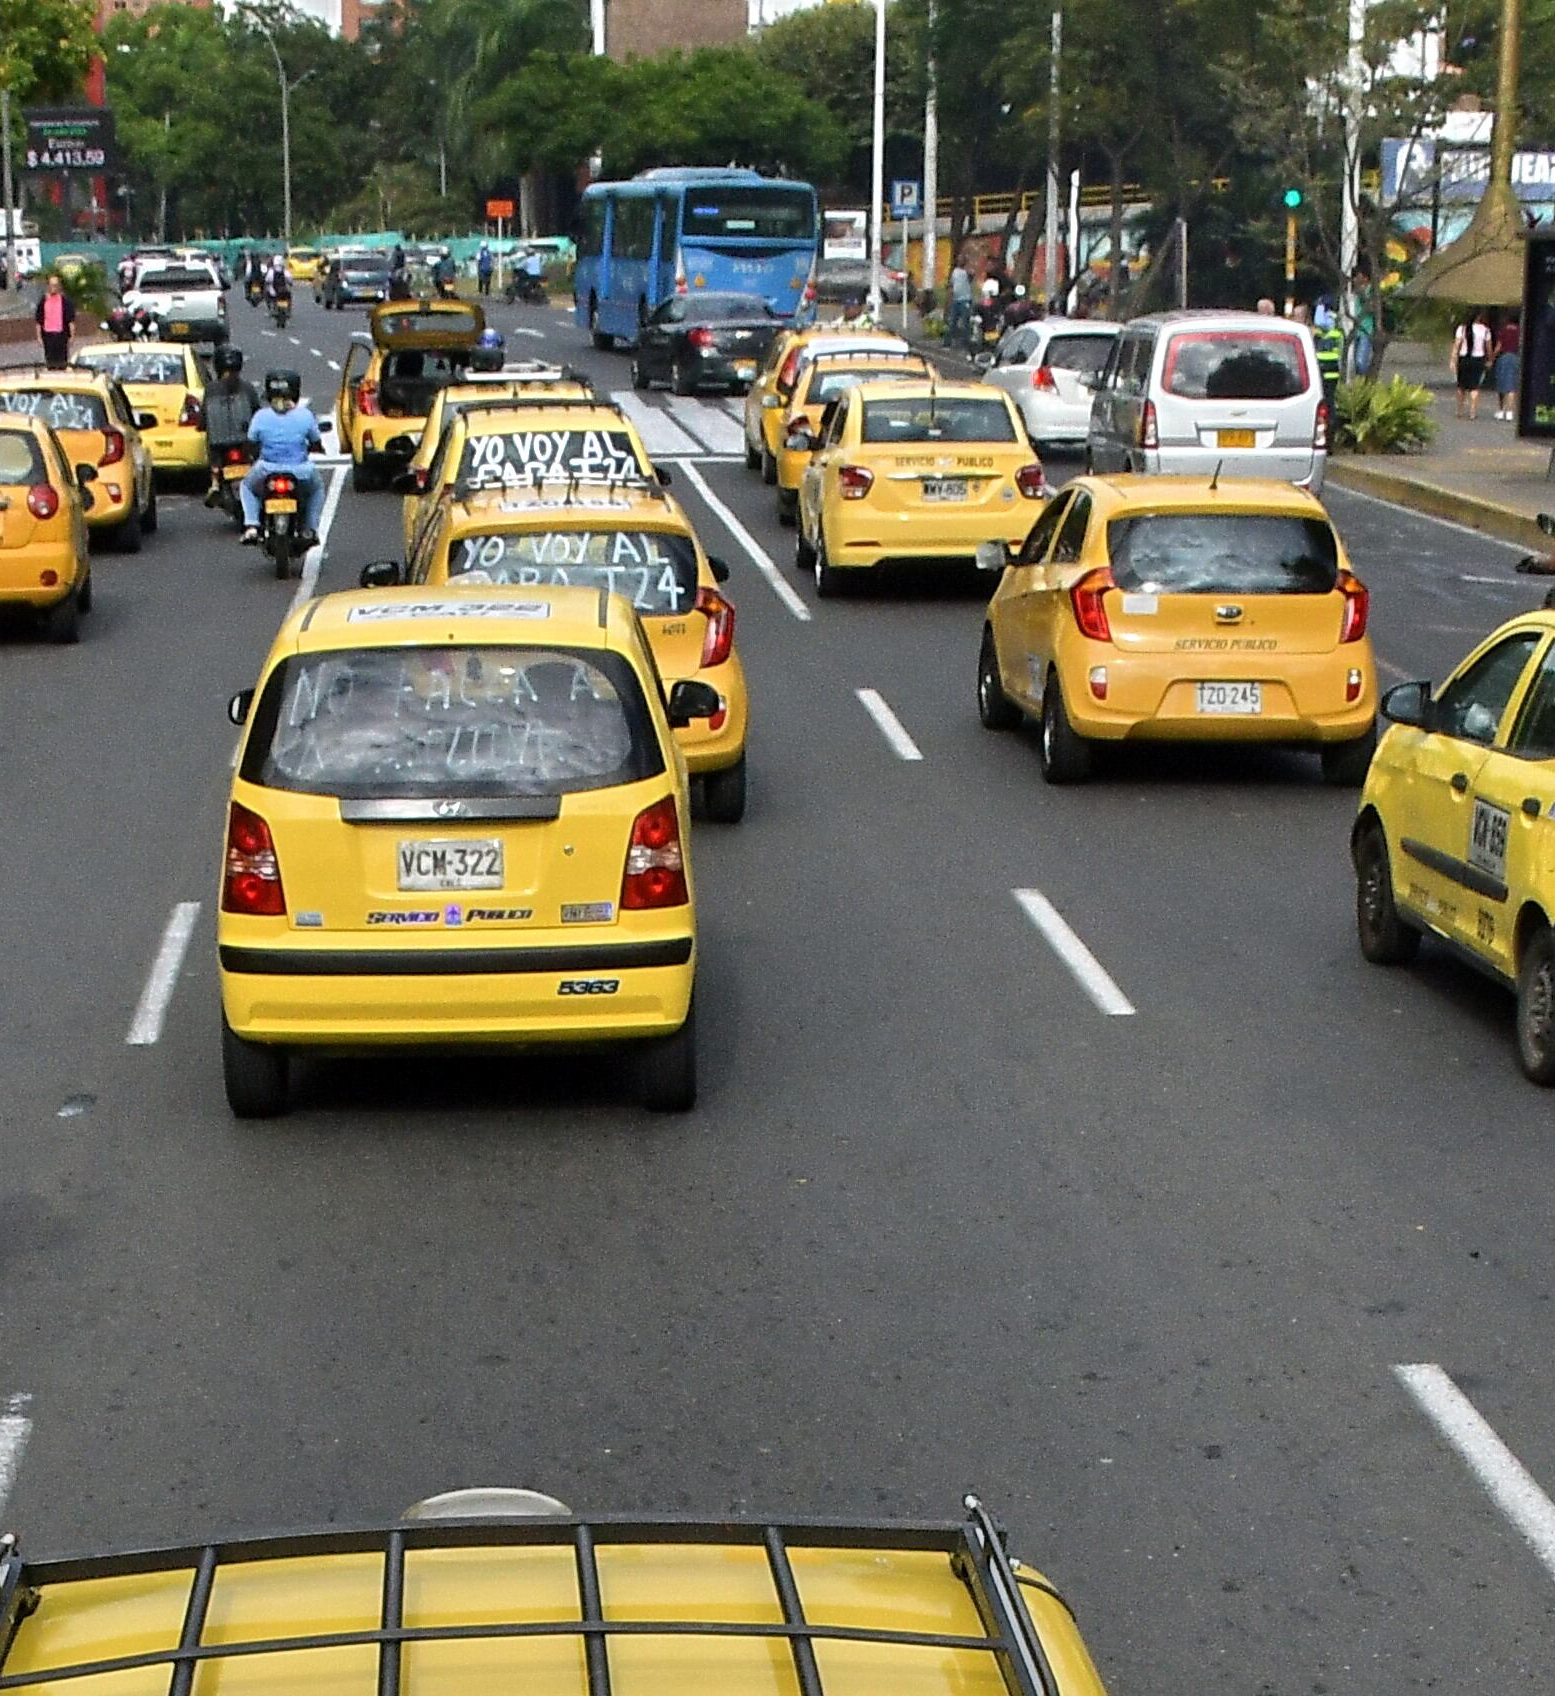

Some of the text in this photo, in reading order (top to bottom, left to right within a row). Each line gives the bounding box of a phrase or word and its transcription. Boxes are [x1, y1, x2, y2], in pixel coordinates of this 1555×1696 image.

[900, 184, 912, 204] P
[3, 392, 42, 417] VOY
[50, 394, 84, 411] AL
[470, 430, 627, 467] YO VOY AL
[896, 456, 994, 468] SERVICIO PUBLICO
[462, 531, 669, 569] YO VOY AL
[1174, 639, 1278, 650] SERVICIO PUBLICO
